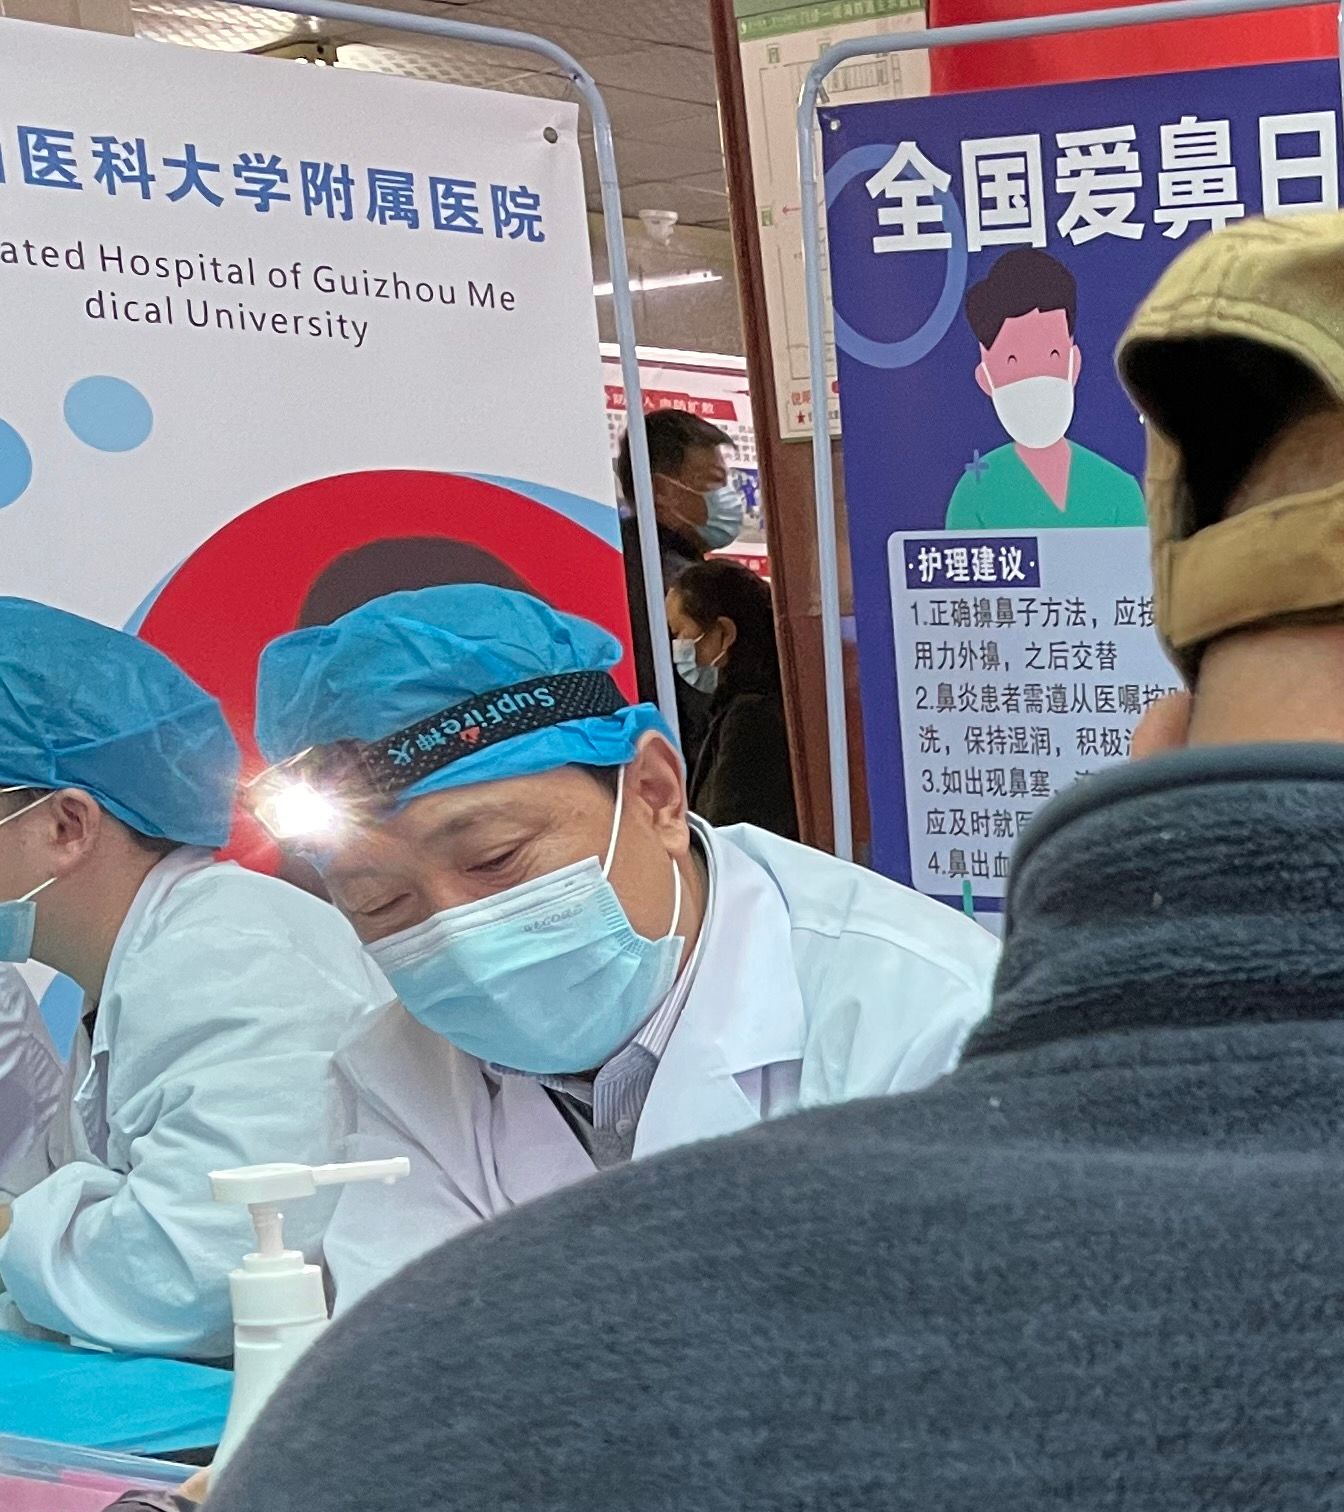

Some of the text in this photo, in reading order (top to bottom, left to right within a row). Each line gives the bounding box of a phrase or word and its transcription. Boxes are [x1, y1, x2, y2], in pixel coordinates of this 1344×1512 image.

[0, 124, 546, 243] 医科大学附属医院
[866, 110, 1339, 252] 全国爱鼻日
[85, 290, 368, 347] dical University
[100, 244, 256, 287] Hospital
[268, 263, 302, 290] of
[313, 265, 457, 304] Guizhou
[468, 281, 516, 311] Me
